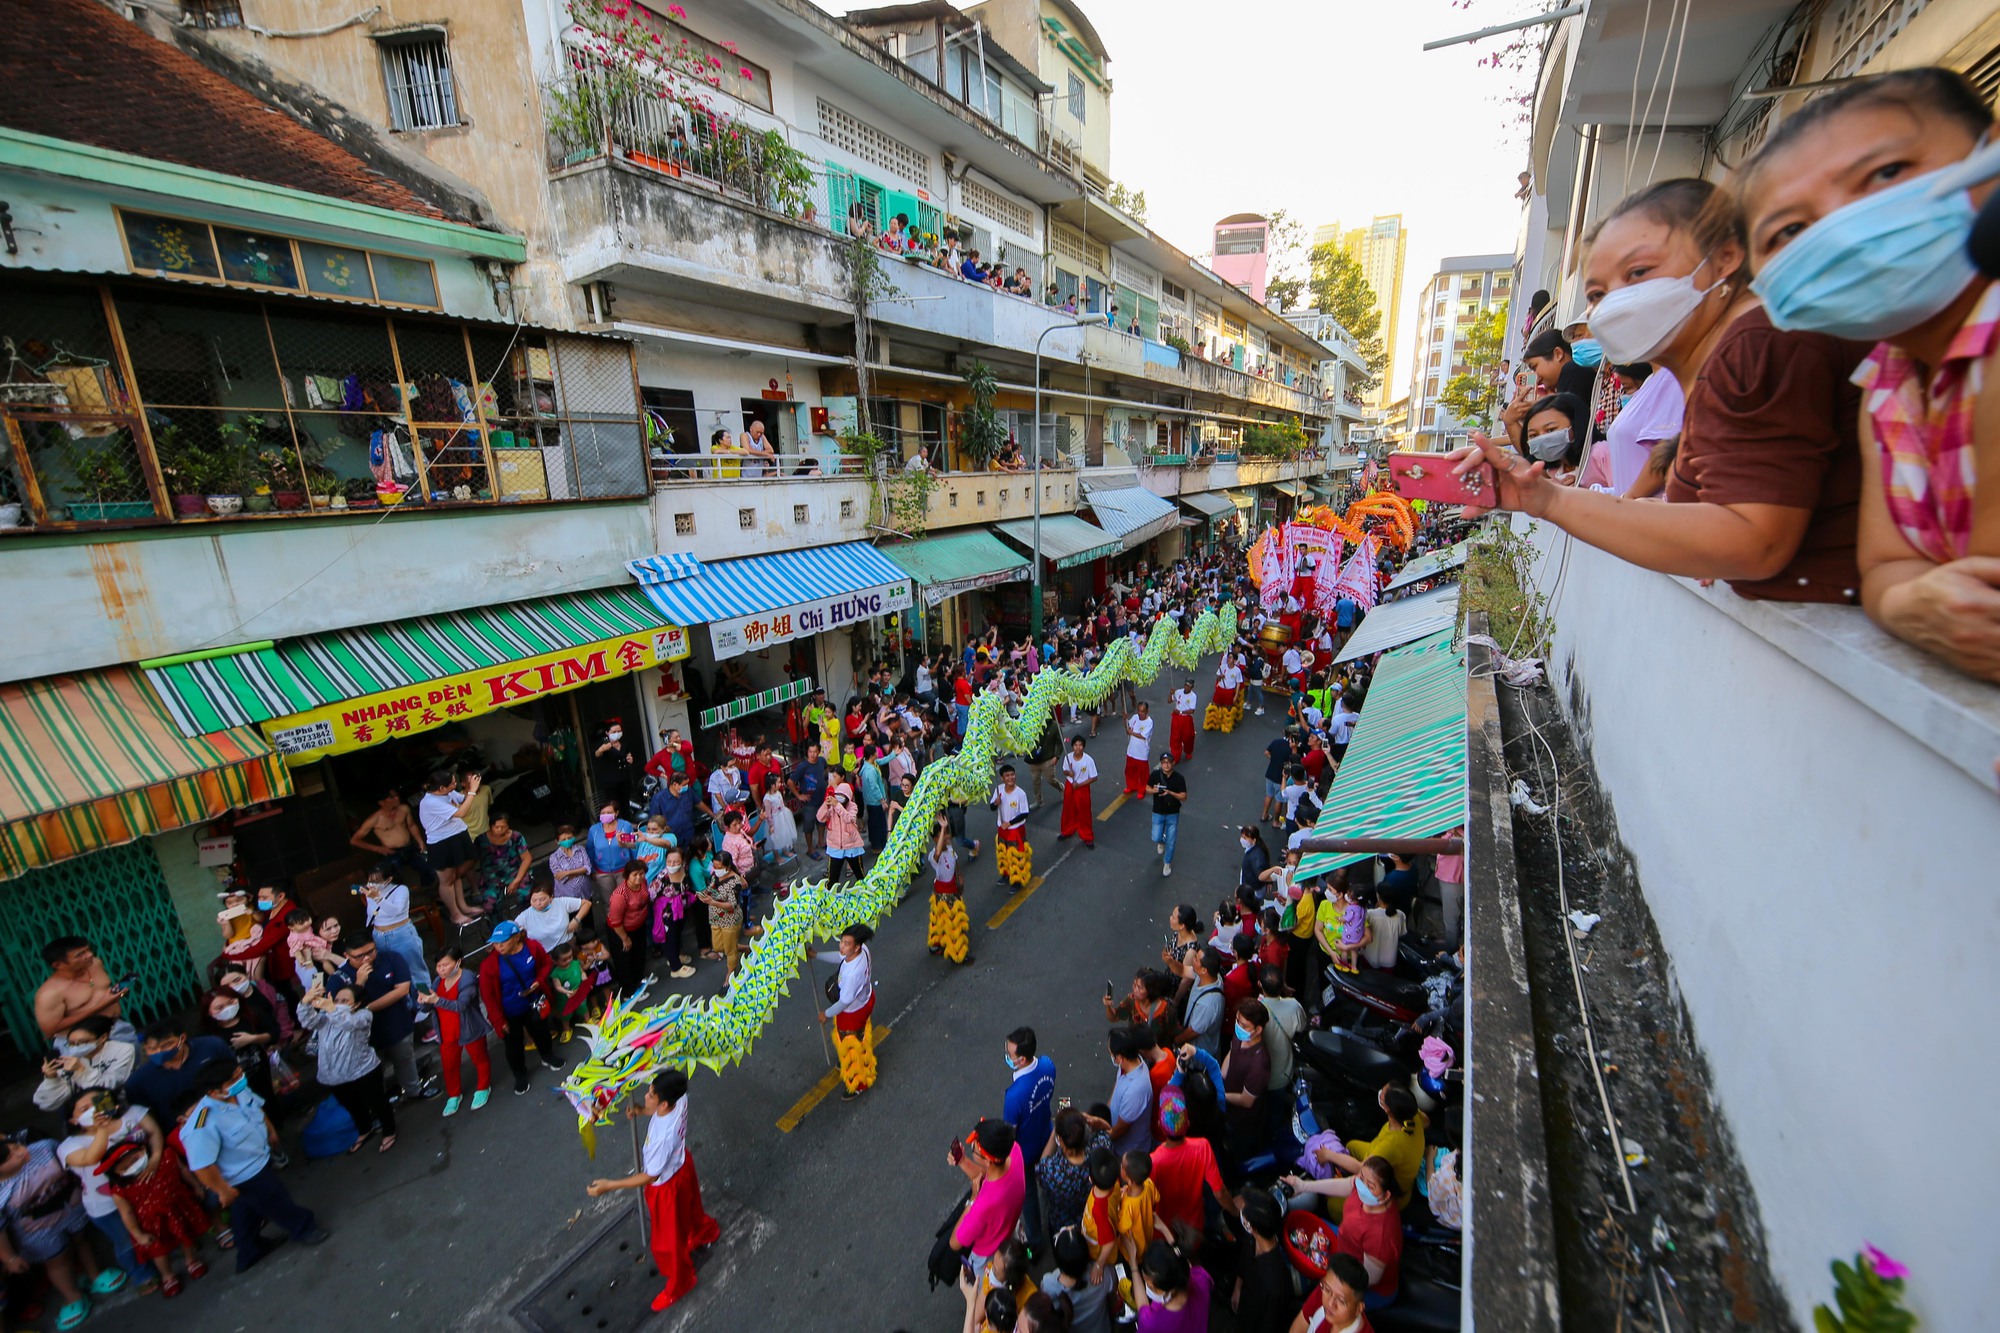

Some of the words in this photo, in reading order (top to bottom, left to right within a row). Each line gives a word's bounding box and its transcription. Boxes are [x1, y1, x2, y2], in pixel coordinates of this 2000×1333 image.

[799, 608, 824, 631] Chị
[829, 594, 882, 624] HƯNG
[656, 630, 681, 644] 7B
[615, 640, 649, 671] 金
[482, 650, 611, 707] KIM
[341, 695, 422, 727] NHANG
[427, 683, 473, 705] ĐÈN
[292, 730, 331, 744] 39733842
[295, 725, 313, 735] Phú
[318, 737, 333, 746] 613
